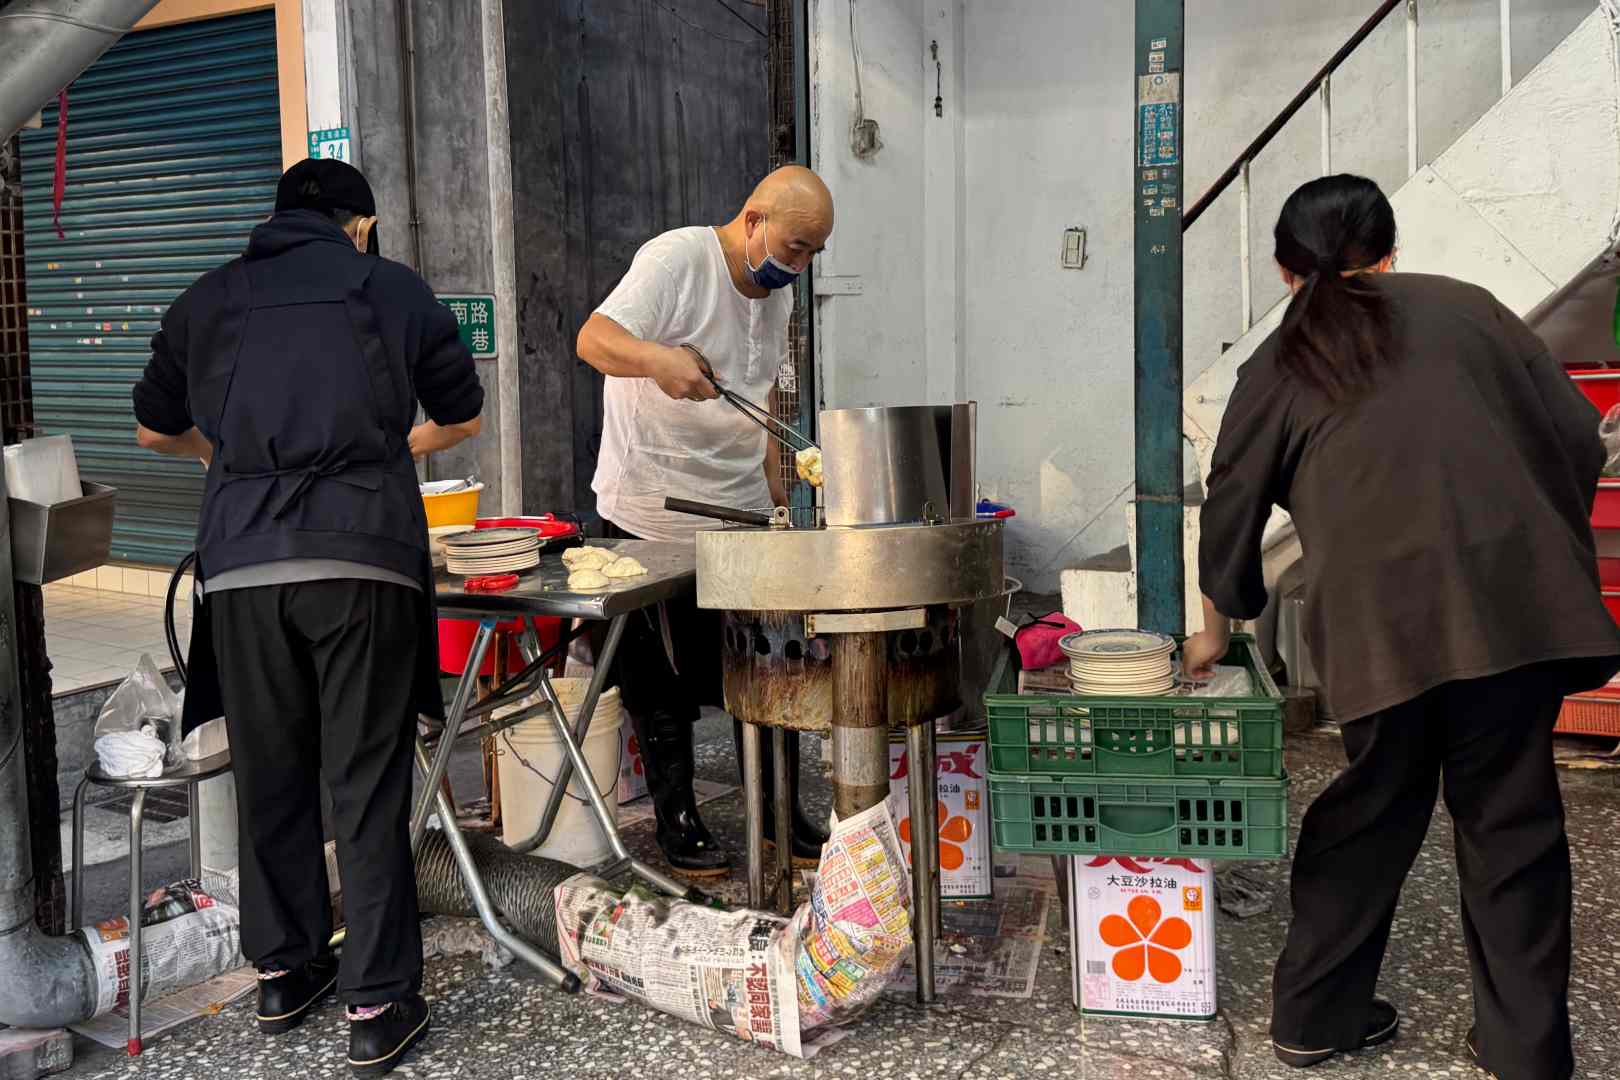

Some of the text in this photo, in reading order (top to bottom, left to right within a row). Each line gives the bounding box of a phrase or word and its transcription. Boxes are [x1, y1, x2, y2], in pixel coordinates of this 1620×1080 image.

[328, 142, 343, 160] 34
[438, 300, 488, 326] 南路
[472, 327, 489, 351] 巷
[1106, 874, 1177, 889] 大豆沙拉油
